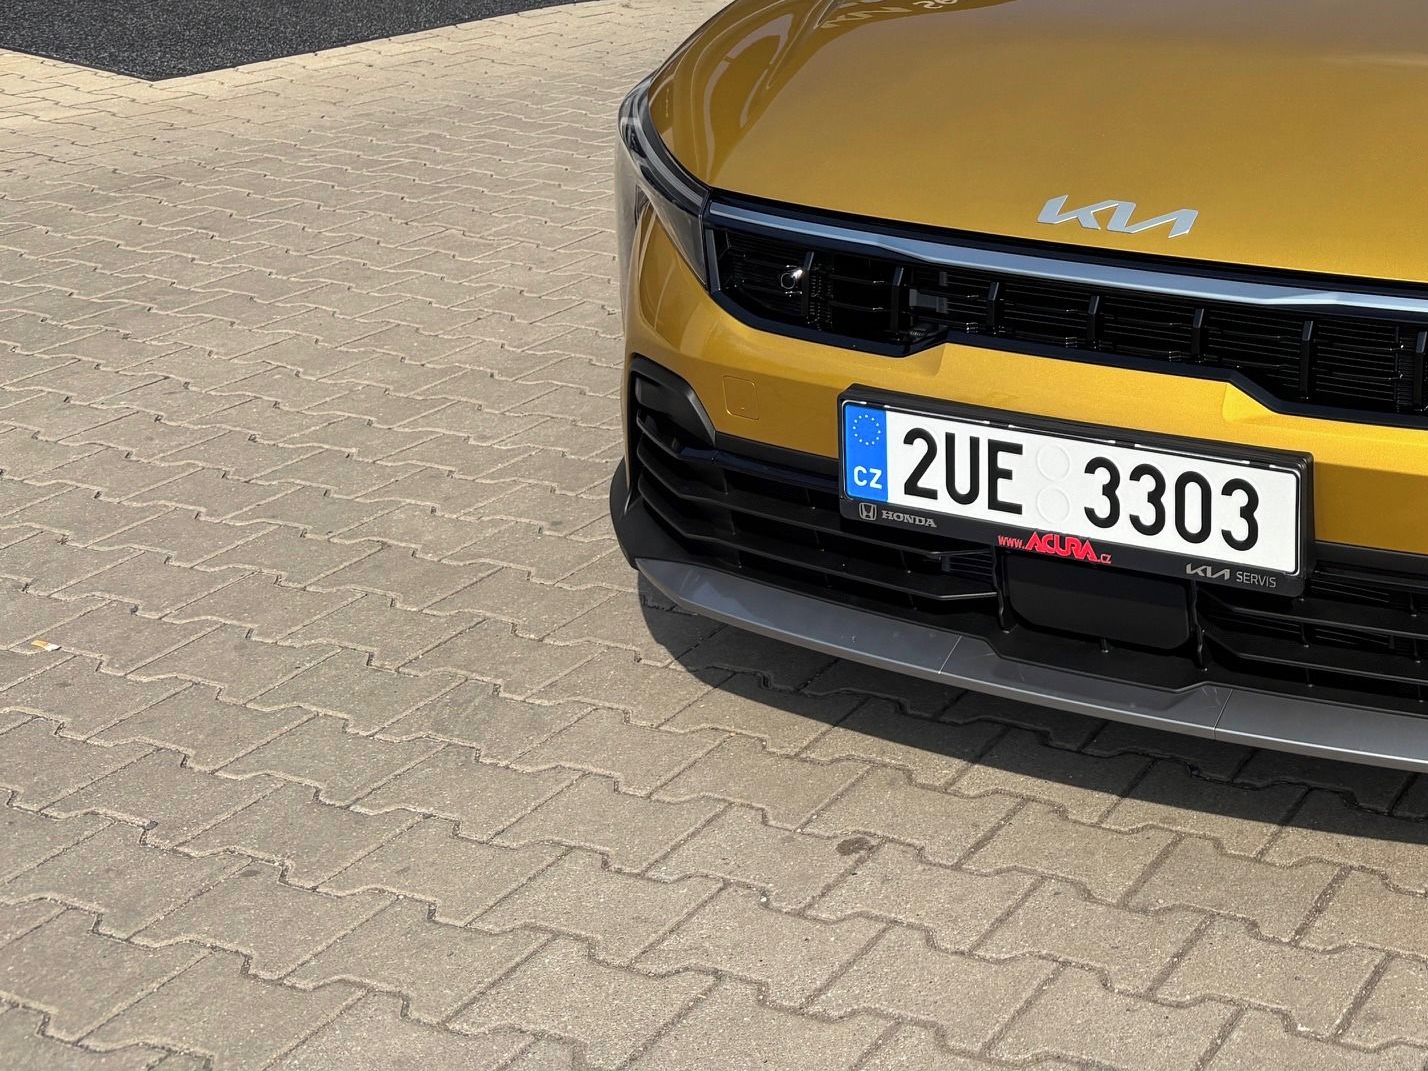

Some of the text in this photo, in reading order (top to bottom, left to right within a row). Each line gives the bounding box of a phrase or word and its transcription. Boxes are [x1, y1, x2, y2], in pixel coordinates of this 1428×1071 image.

[1036, 194, 1199, 239] KIA
[853, 466, 882, 489] CZ
[902, 427, 1260, 552] 2UE 3303
[881, 510, 937, 528] HONDA
[1185, 562, 1277, 588] KIA SERVIS
